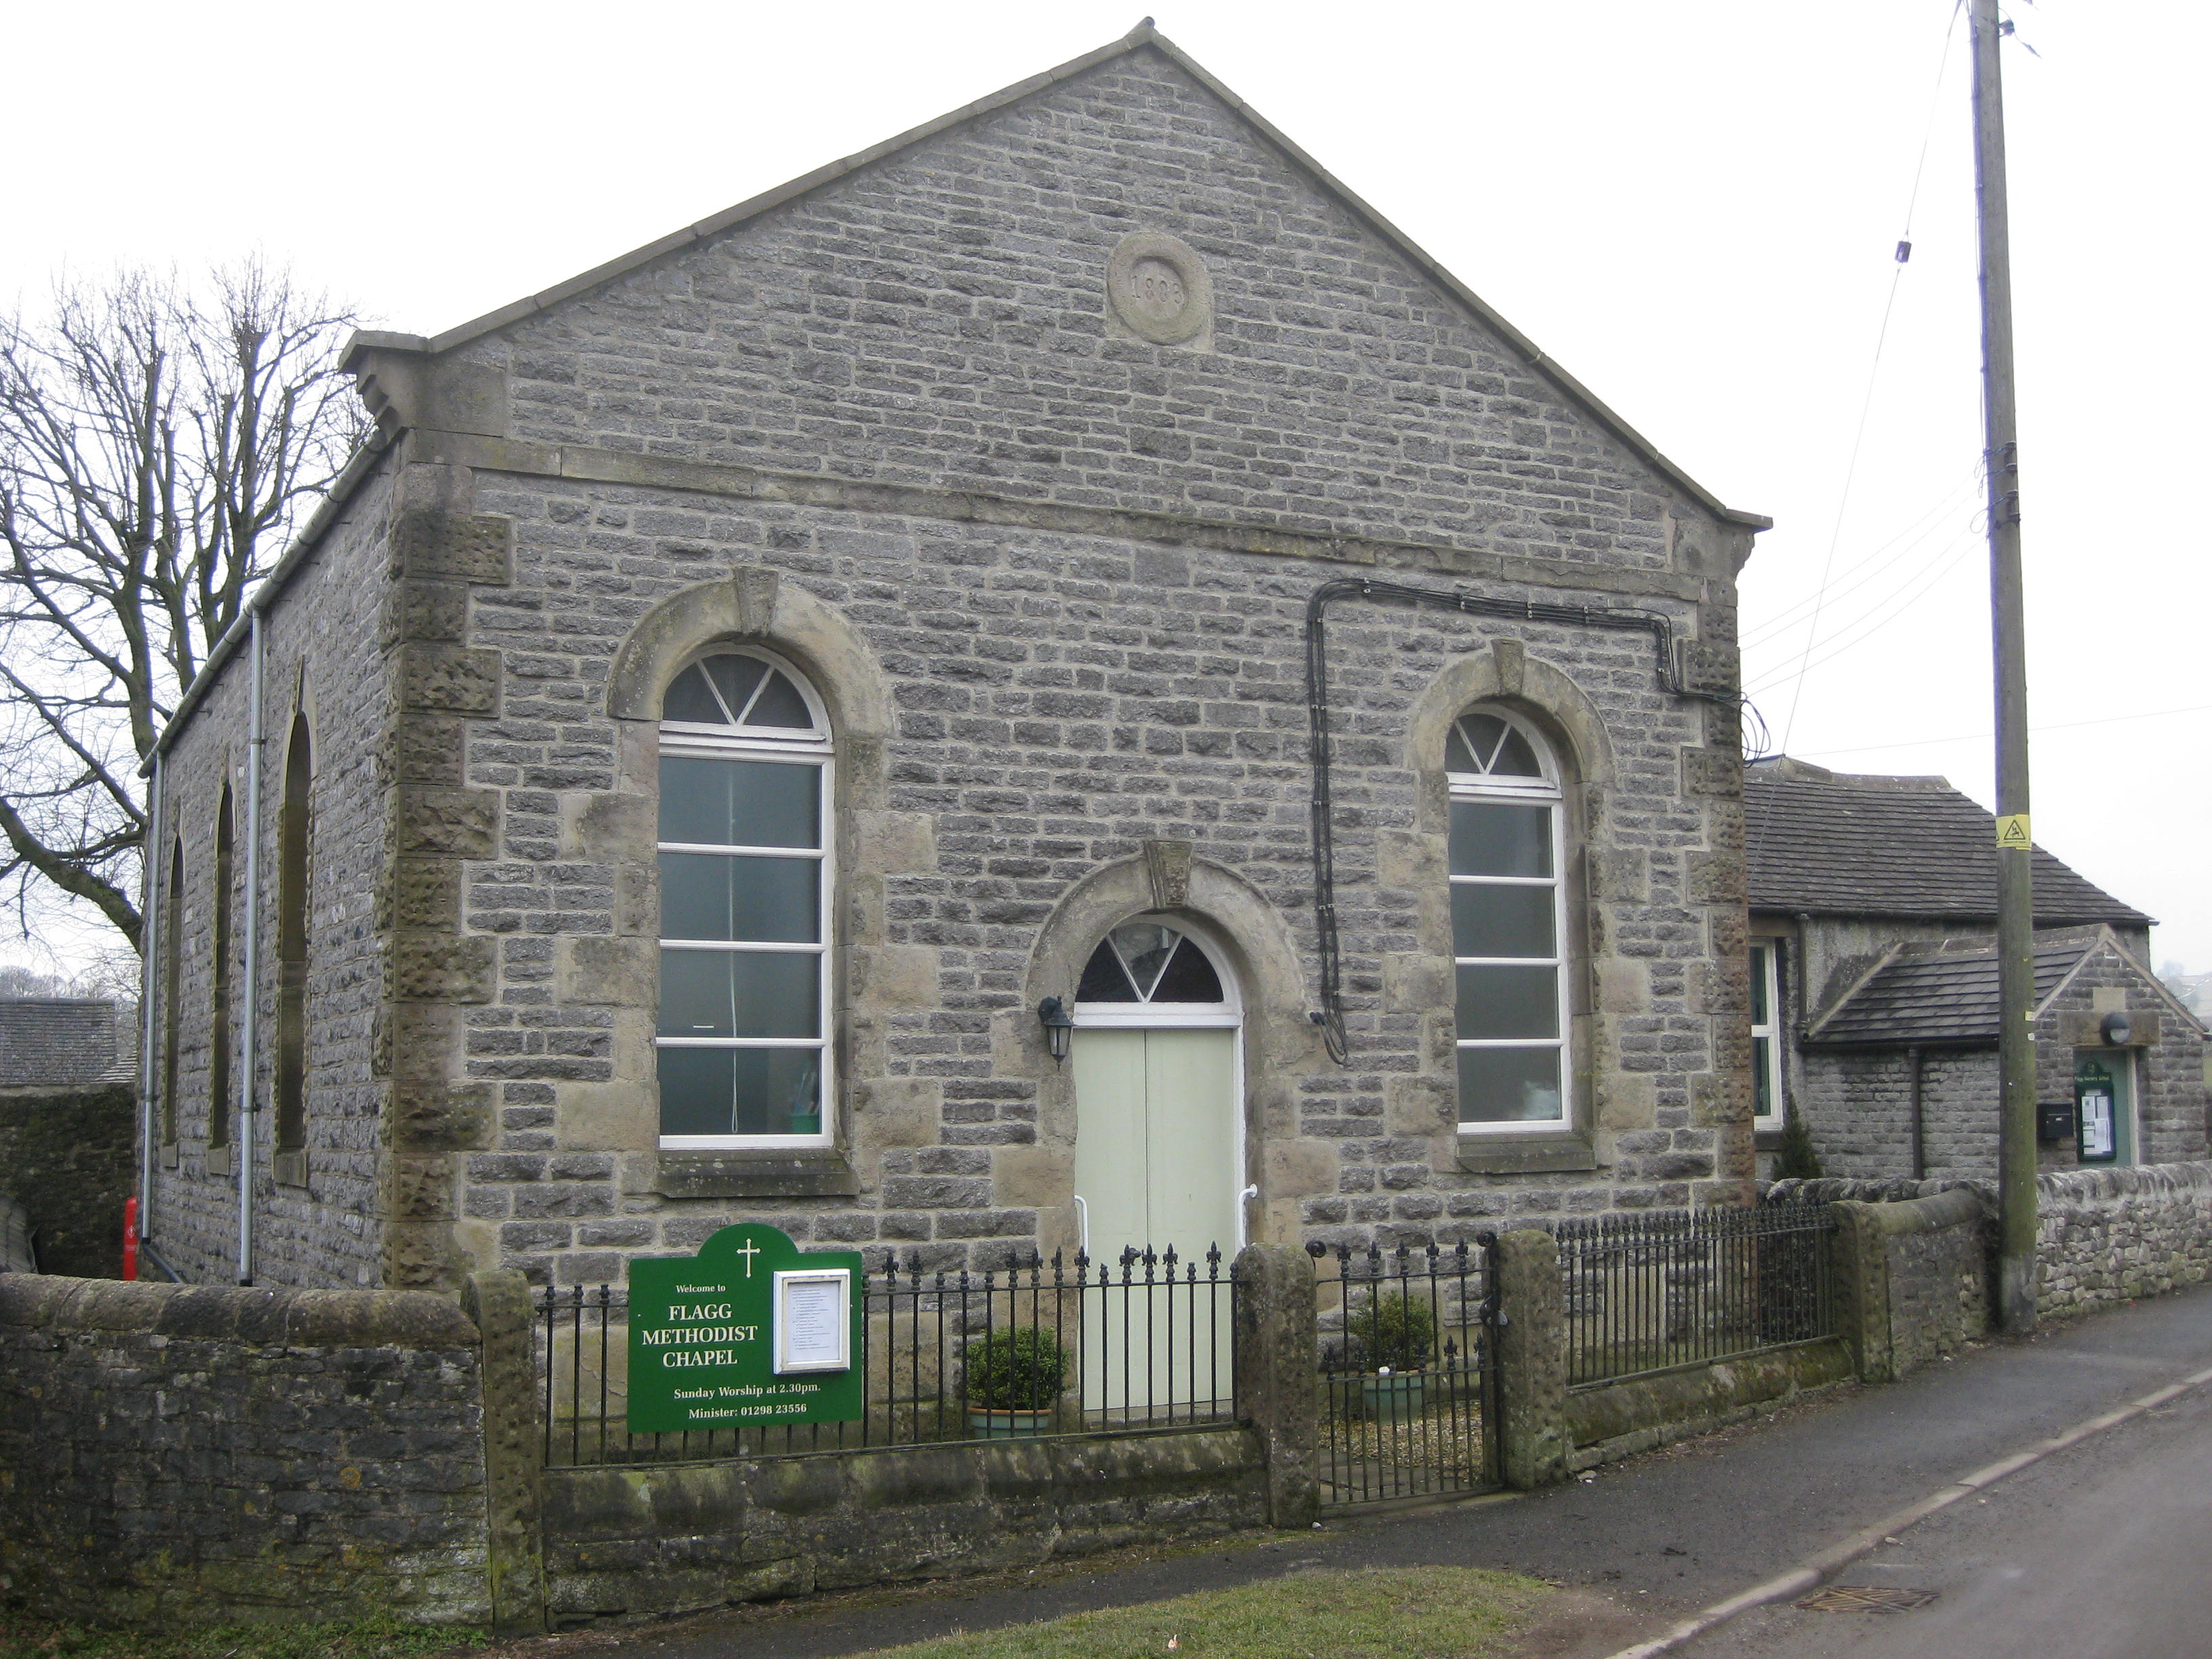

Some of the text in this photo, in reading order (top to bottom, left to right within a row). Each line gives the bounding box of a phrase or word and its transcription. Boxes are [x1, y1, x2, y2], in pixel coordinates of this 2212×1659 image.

[676, 1284, 715, 1293] Welcome
[668, 1303, 733, 1321] FLAGG
[642, 1325, 758, 1345] METHODIST
[662, 1349, 738, 1368] CHAPEL
[674, 1382, 821, 1400] Sunday Worship at 2.30pm.
[688, 1403, 807, 1419] Minister: 01298 23556
